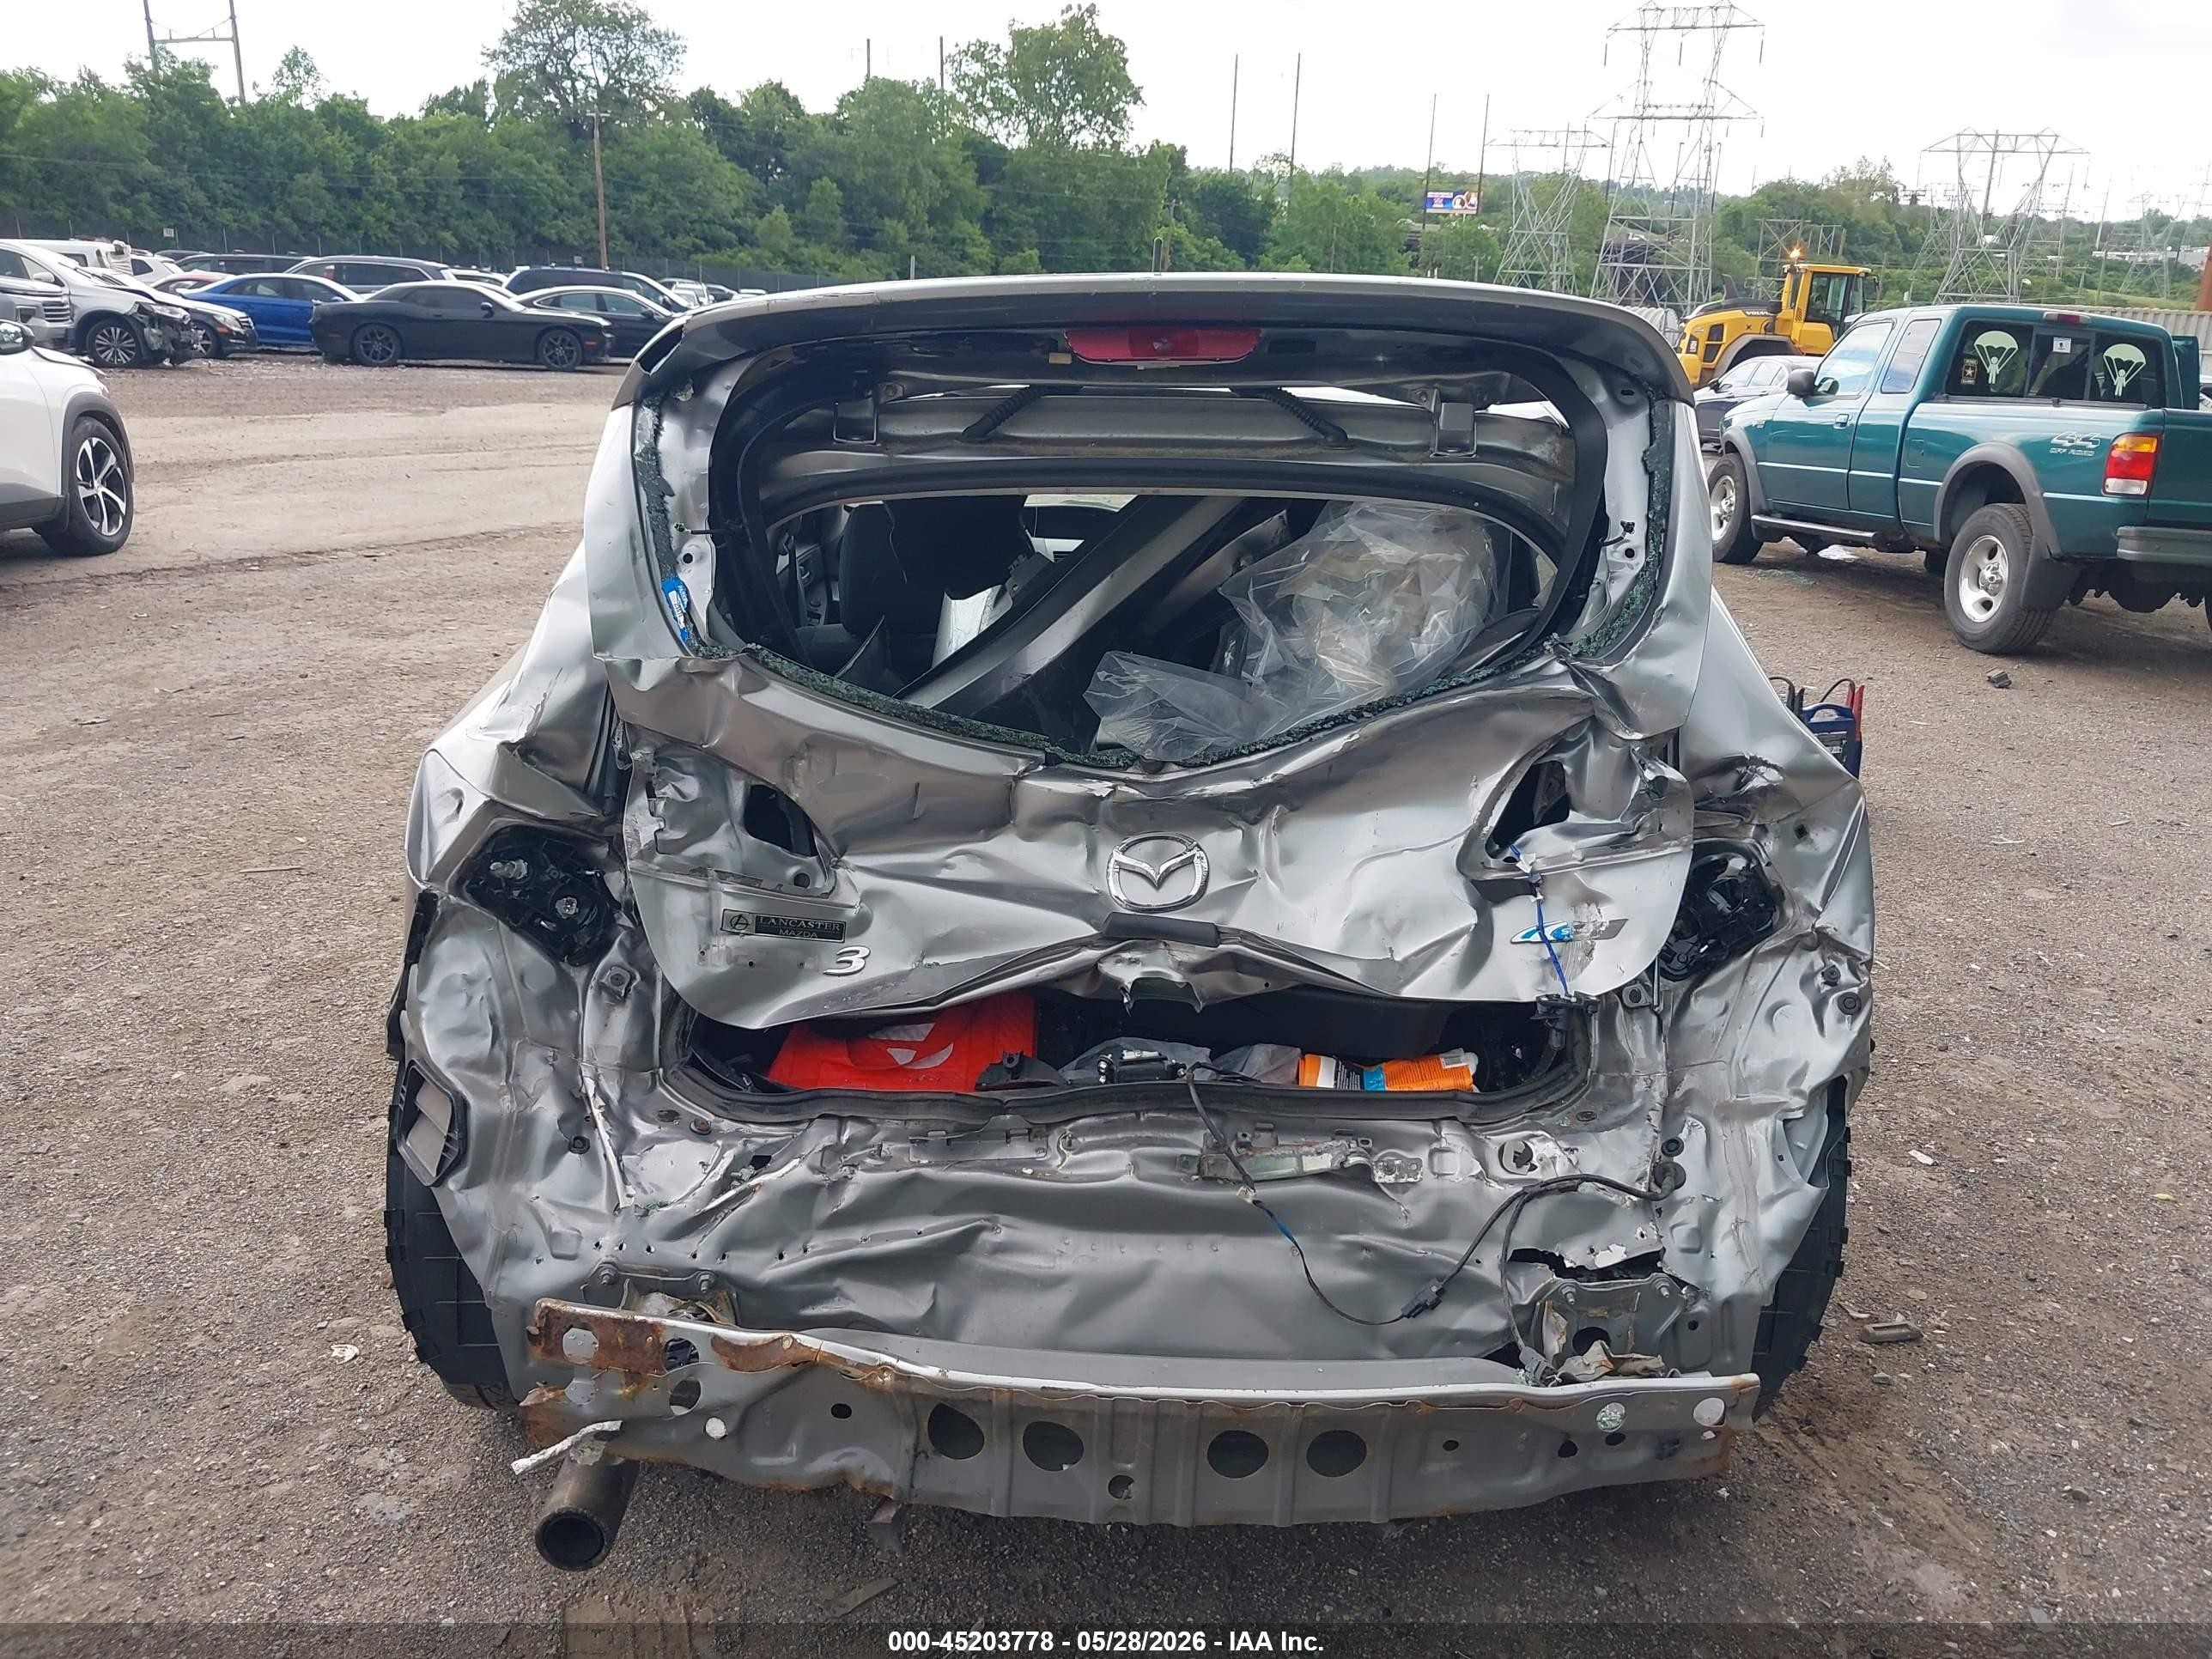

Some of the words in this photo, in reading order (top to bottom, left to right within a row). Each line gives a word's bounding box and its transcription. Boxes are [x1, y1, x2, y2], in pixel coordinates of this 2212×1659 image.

[760, 916, 841, 931] LANCASTER
[779, 929, 818, 939] MAZDA
[823, 945, 872, 977] 3
